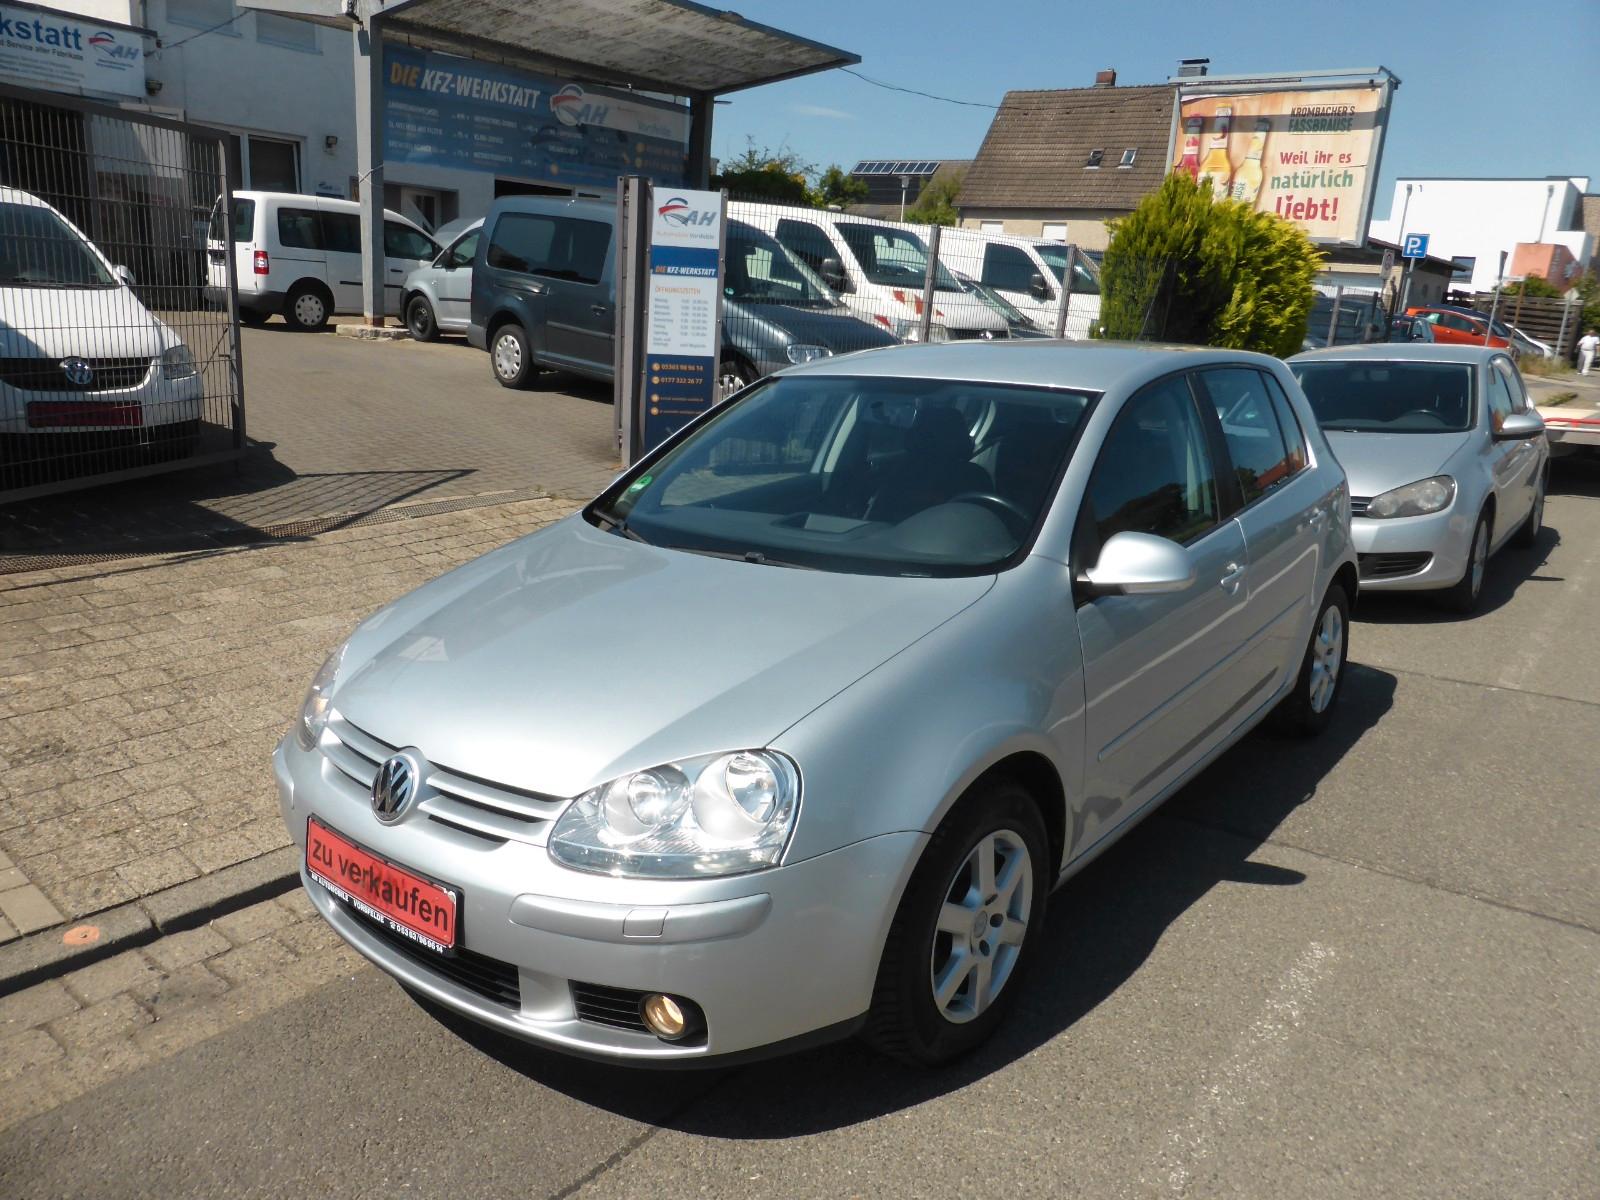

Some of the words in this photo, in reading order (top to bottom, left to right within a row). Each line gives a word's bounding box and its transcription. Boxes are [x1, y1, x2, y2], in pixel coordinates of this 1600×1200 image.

[111, 44, 139, 60] AH
[389, 62, 420, 88] DIE
[420, 69, 541, 109] KFZ-WERKSTATT
[577, 103, 609, 123] AH
[1288, 118, 1354, 133] FASSBRAUSE
[1280, 151, 1308, 165] Weil
[1314, 150, 1334, 164] ihr
[1338, 152, 1352, 164] es
[1271, 169, 1354, 190] natürlich
[1275, 195, 1339, 222] liebt!
[688, 210, 717, 226] AH
[1406, 237, 1421, 255] P
[667, 266, 716, 276] KFZ-WERKSTATT
[312, 838, 333, 868] zu
[338, 853, 448, 932] verkaufen
